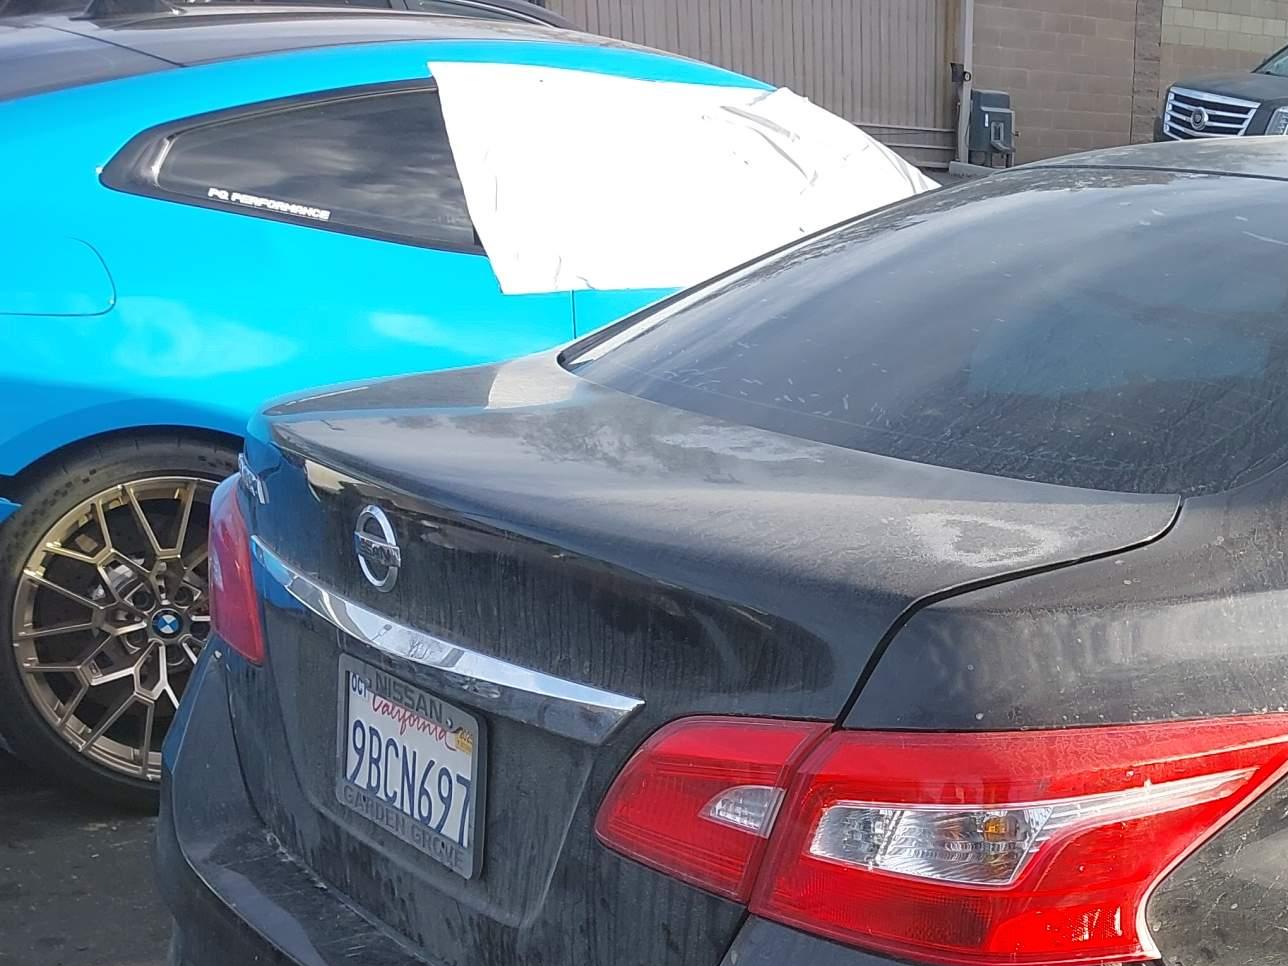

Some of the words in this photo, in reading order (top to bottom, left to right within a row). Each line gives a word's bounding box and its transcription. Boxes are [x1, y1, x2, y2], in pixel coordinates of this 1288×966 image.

[230, 192, 332, 220] PERFORMANCE
[374, 670, 443, 725] NISSAN
[344, 719, 472, 848] 9BCN697
[343, 784, 406, 836] GARDEN
[410, 823, 465, 870] GROVE
